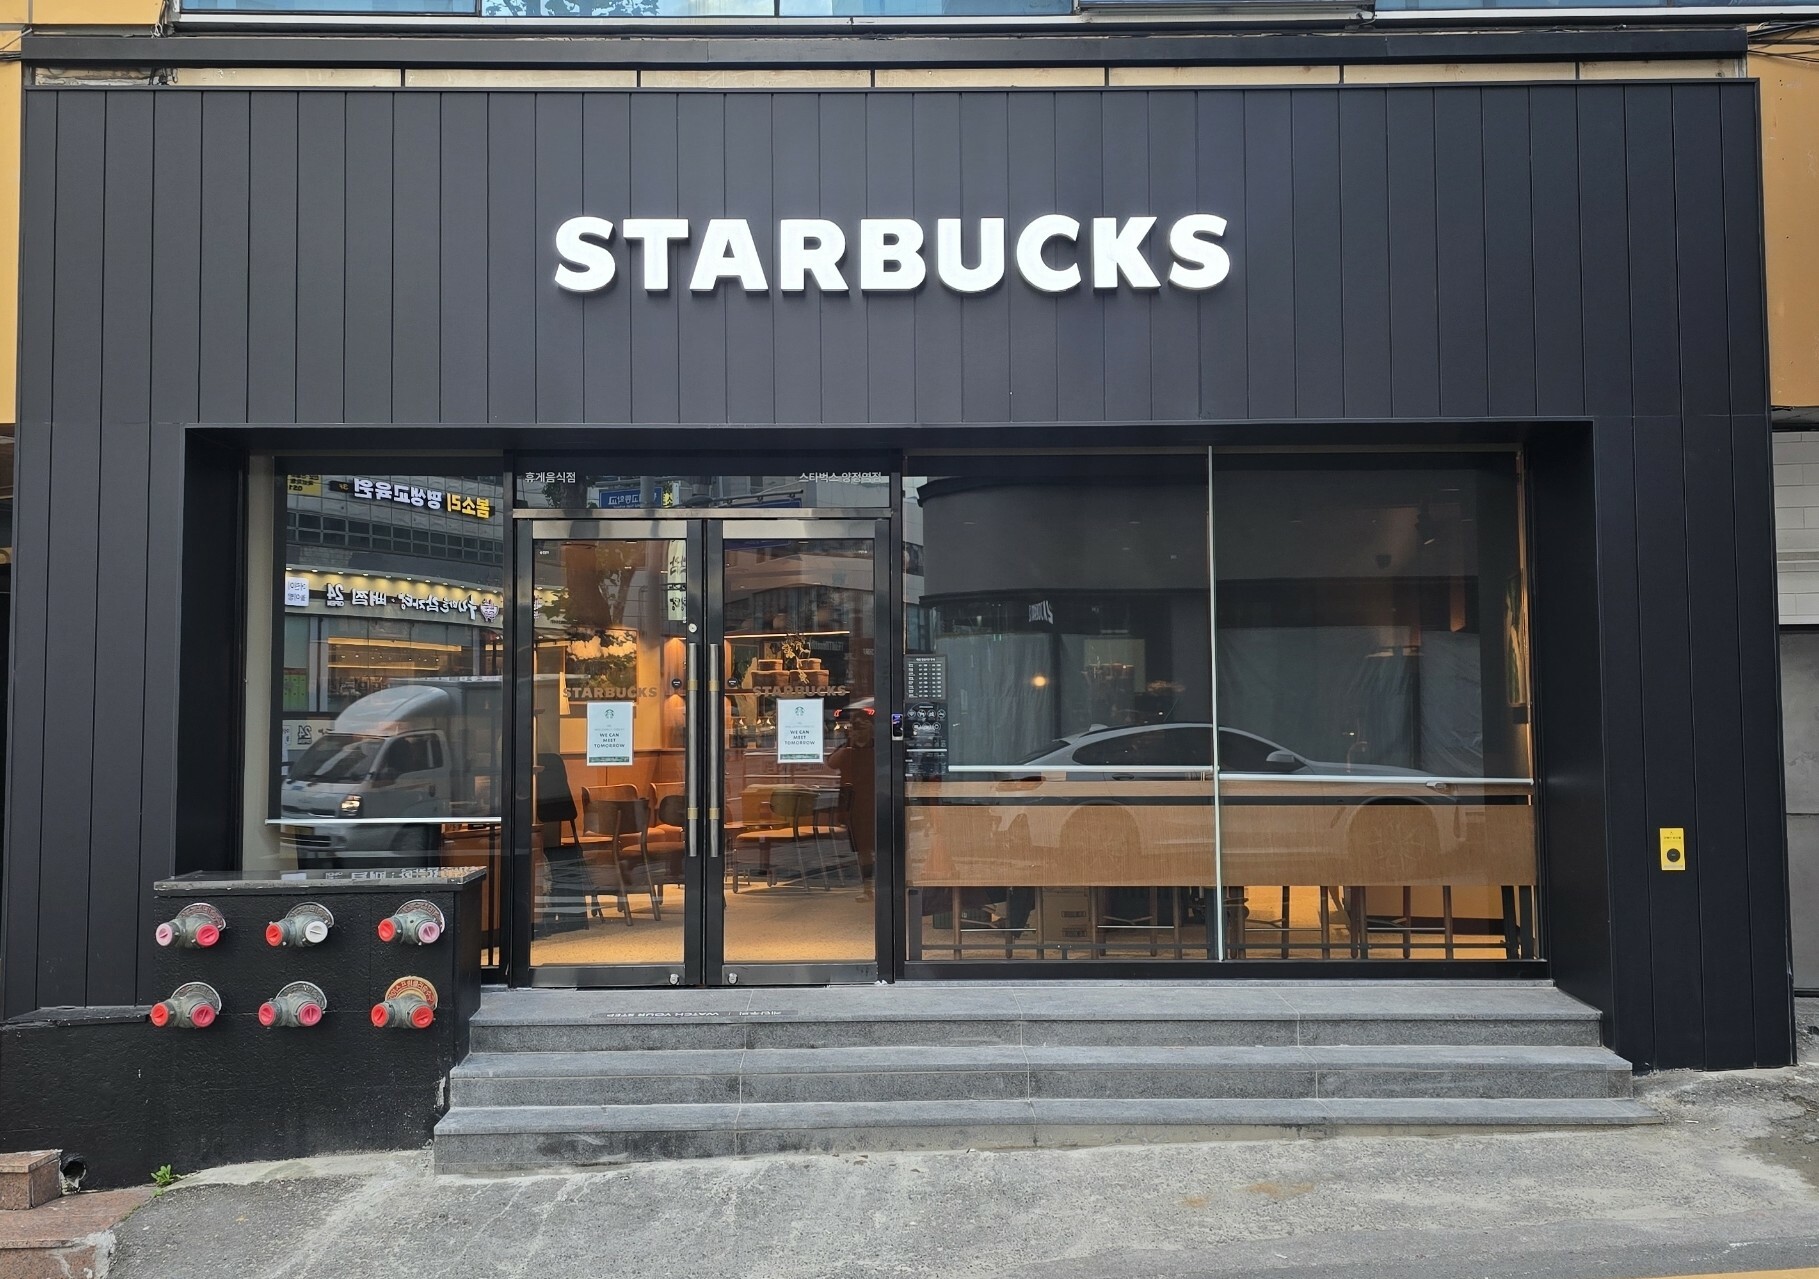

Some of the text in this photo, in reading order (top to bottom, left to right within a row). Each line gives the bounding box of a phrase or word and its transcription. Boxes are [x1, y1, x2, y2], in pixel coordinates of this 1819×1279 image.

[554, 214, 1231, 293] STARBUCKS
[524, 471, 577, 484] 휴게음식점
[798, 472, 839, 483] 스타벅스
[562, 686, 658, 698] STARBUCKS
[752, 685, 847, 697] STARBUCKS
